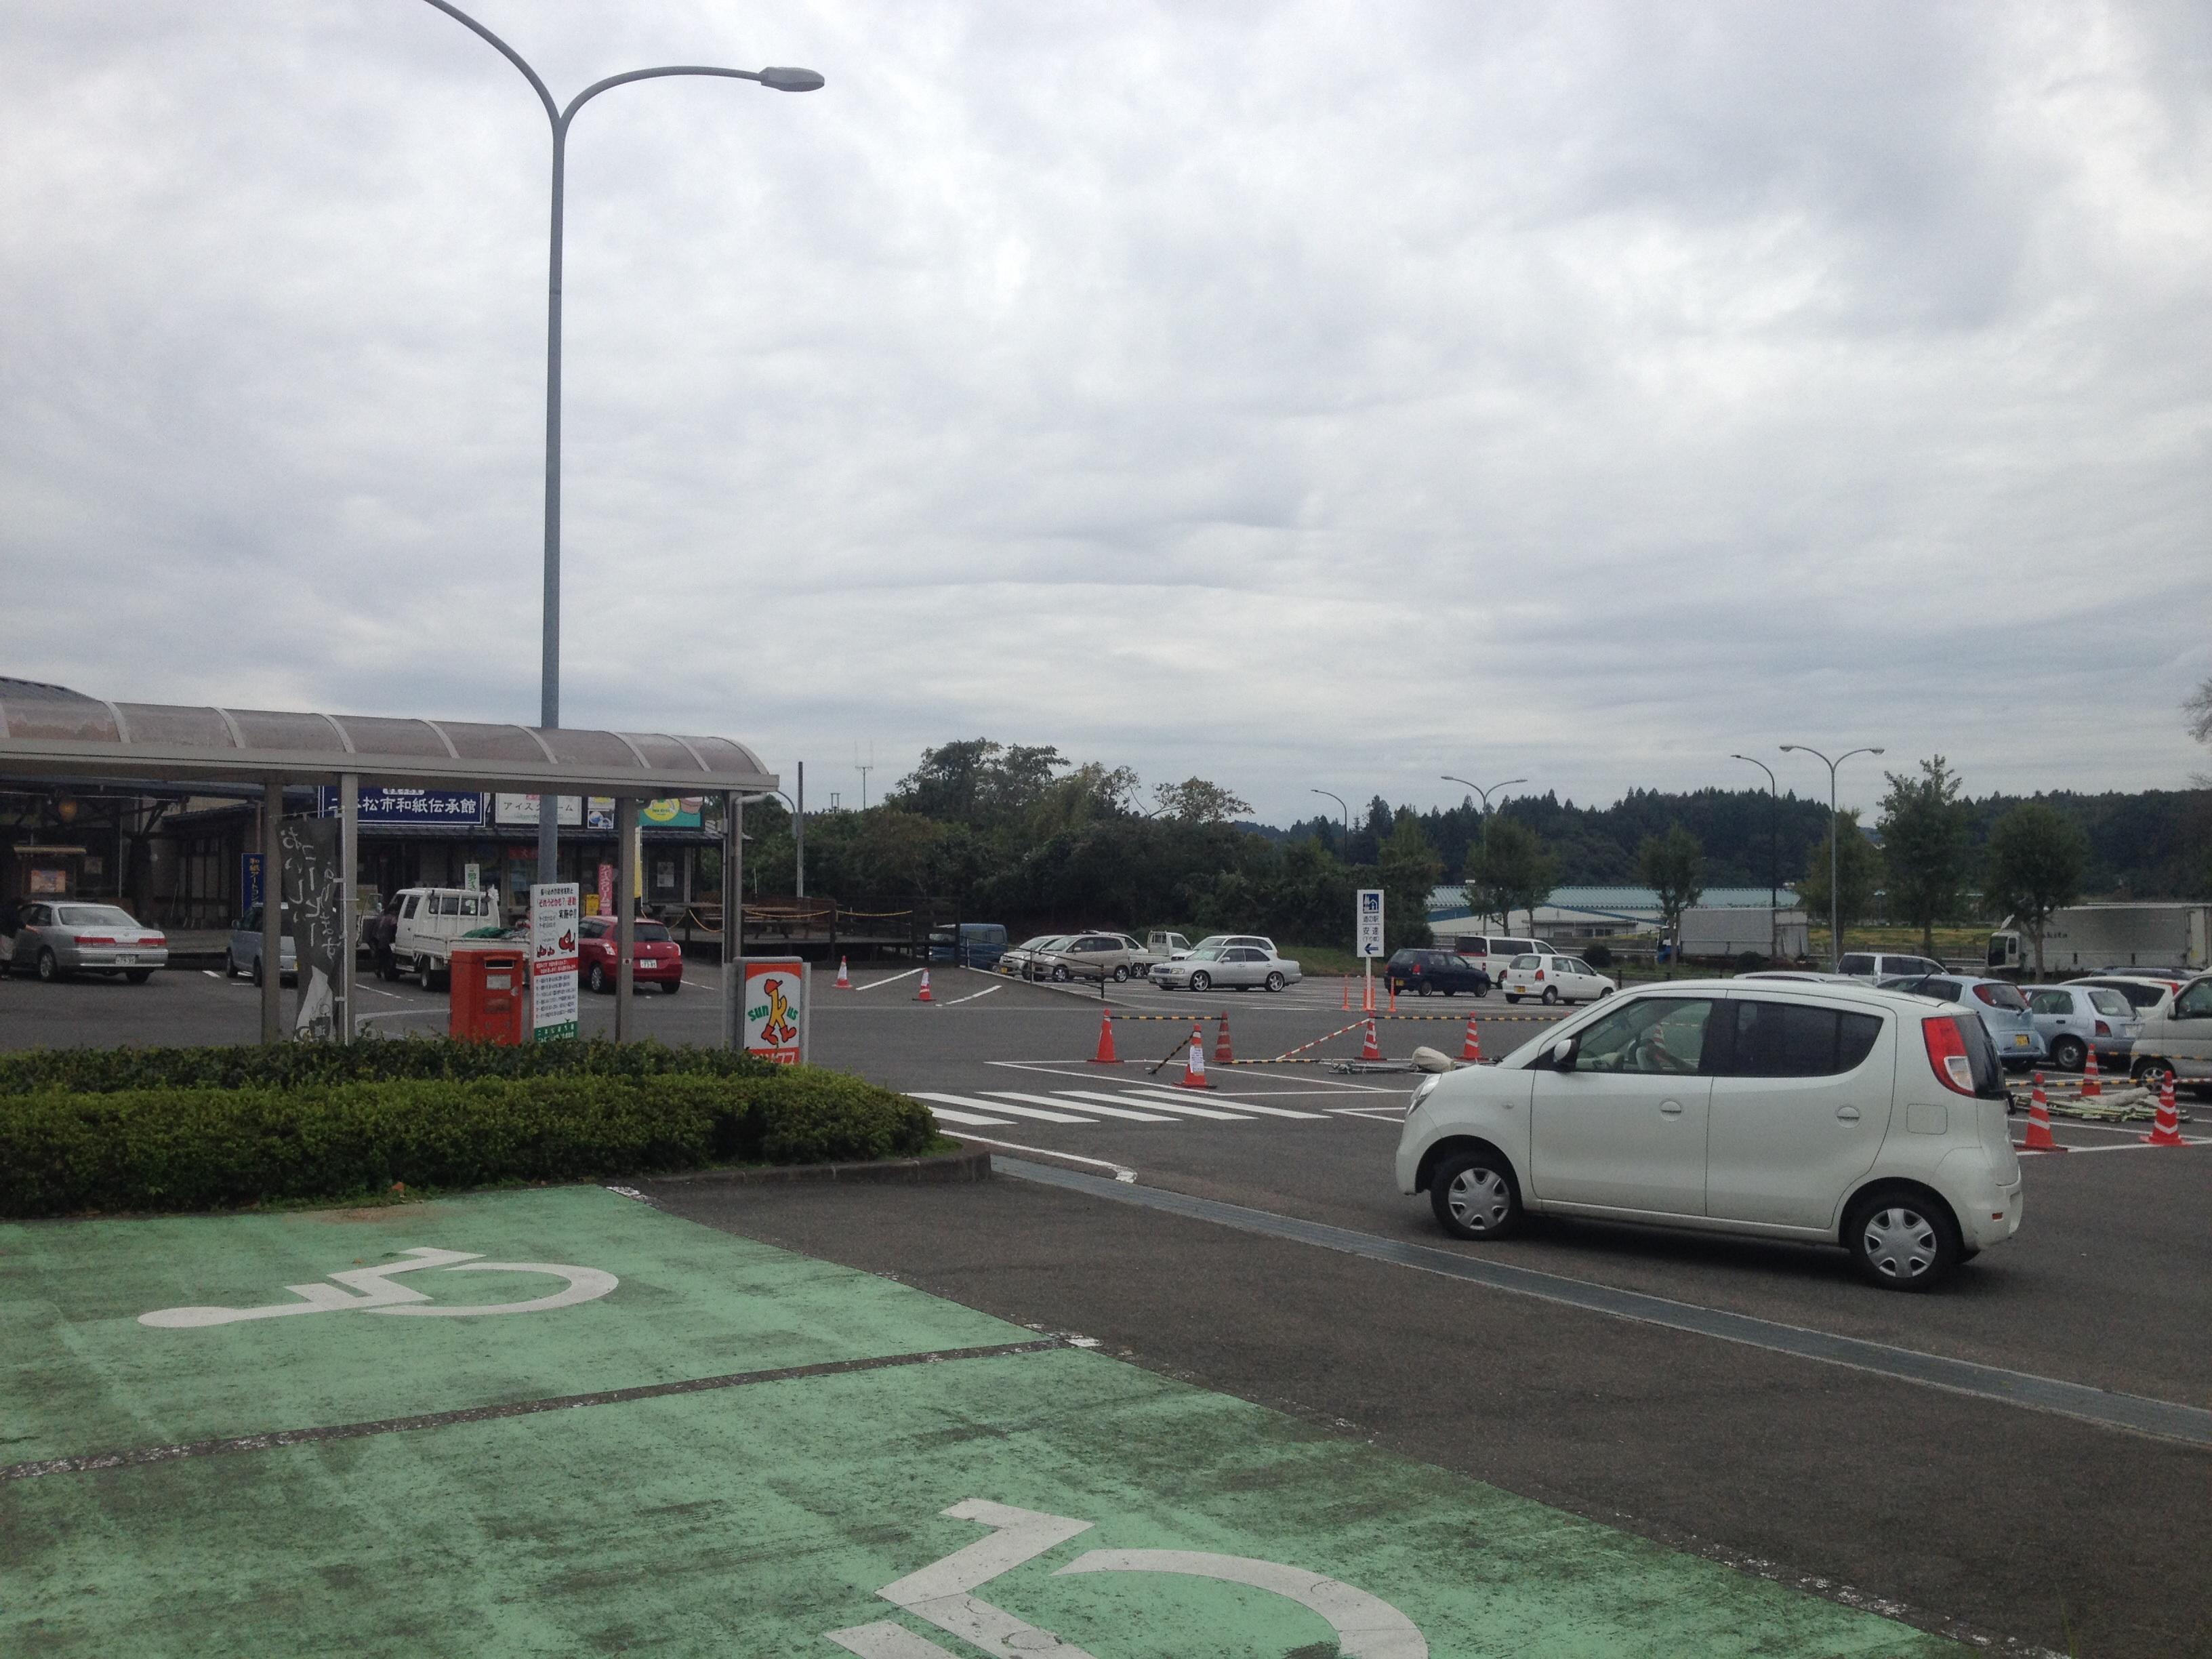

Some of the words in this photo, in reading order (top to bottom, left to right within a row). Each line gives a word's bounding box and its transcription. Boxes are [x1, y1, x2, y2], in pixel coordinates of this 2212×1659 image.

[329, 797, 476, 815] 二松市和紙伝承館
